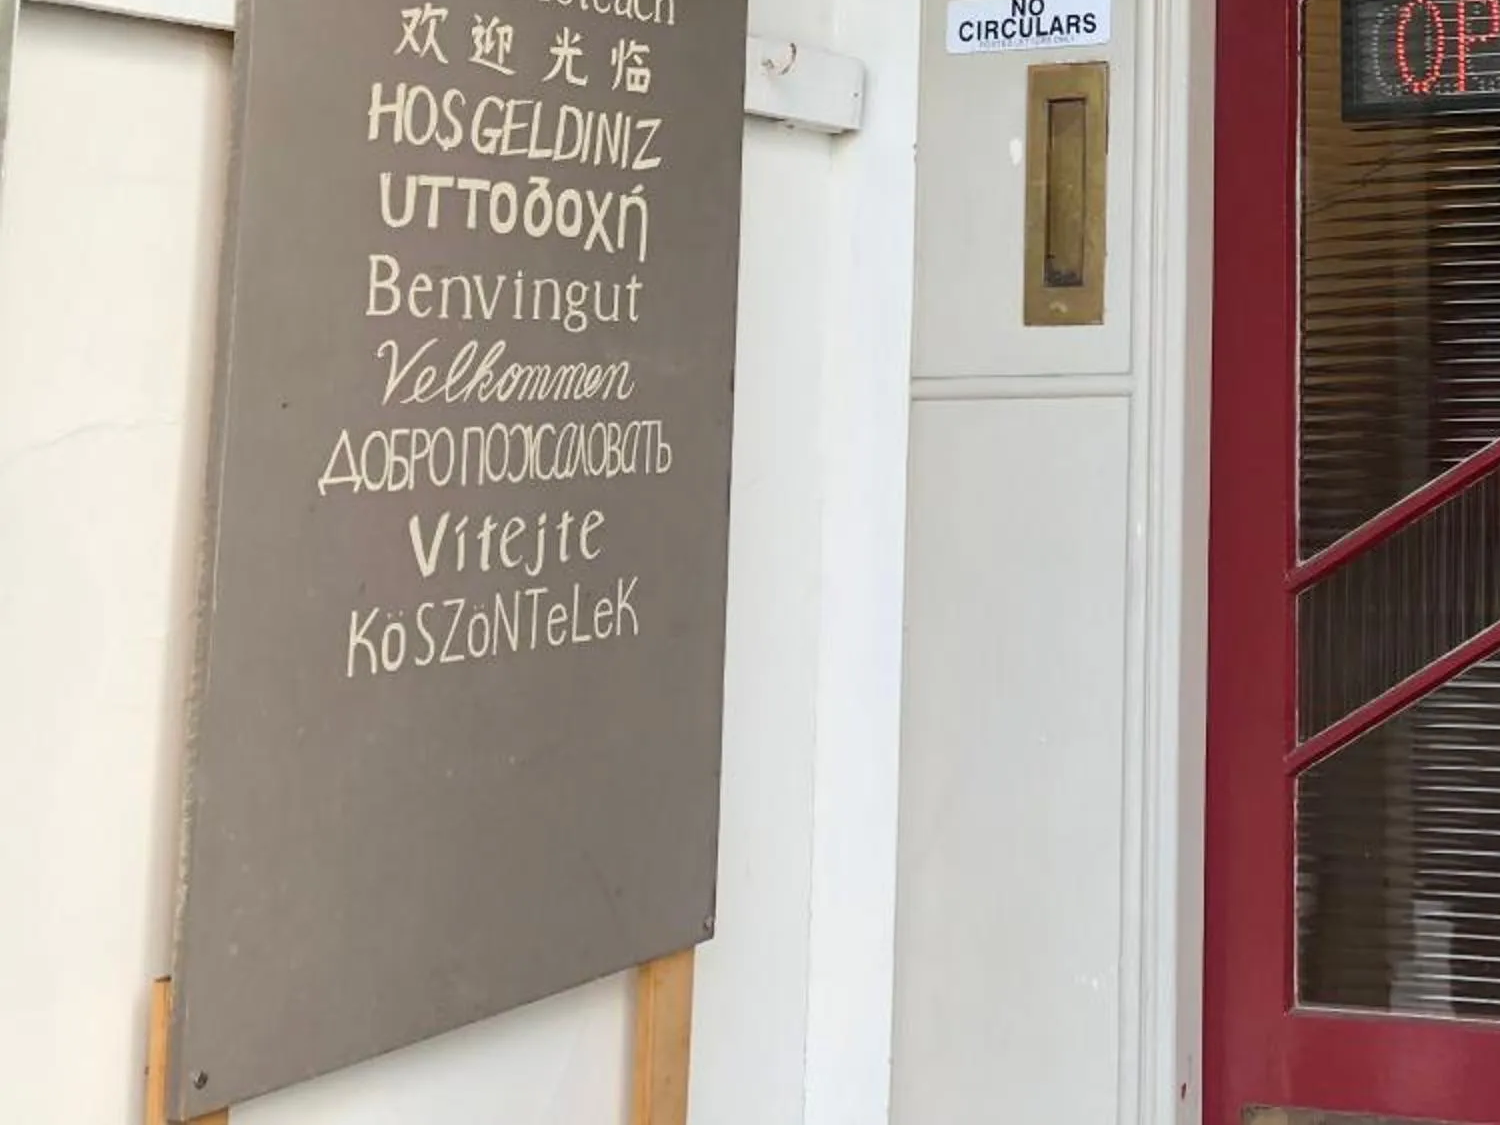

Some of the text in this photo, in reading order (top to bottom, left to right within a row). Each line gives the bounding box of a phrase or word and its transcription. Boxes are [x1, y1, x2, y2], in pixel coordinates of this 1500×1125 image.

[394, 2, 653, 94] 欢迎光临
[958, 13, 1098, 42] CIRCULARS
[365, 254, 643, 332] Benvingut
[377, 338, 635, 405] Velkommen
